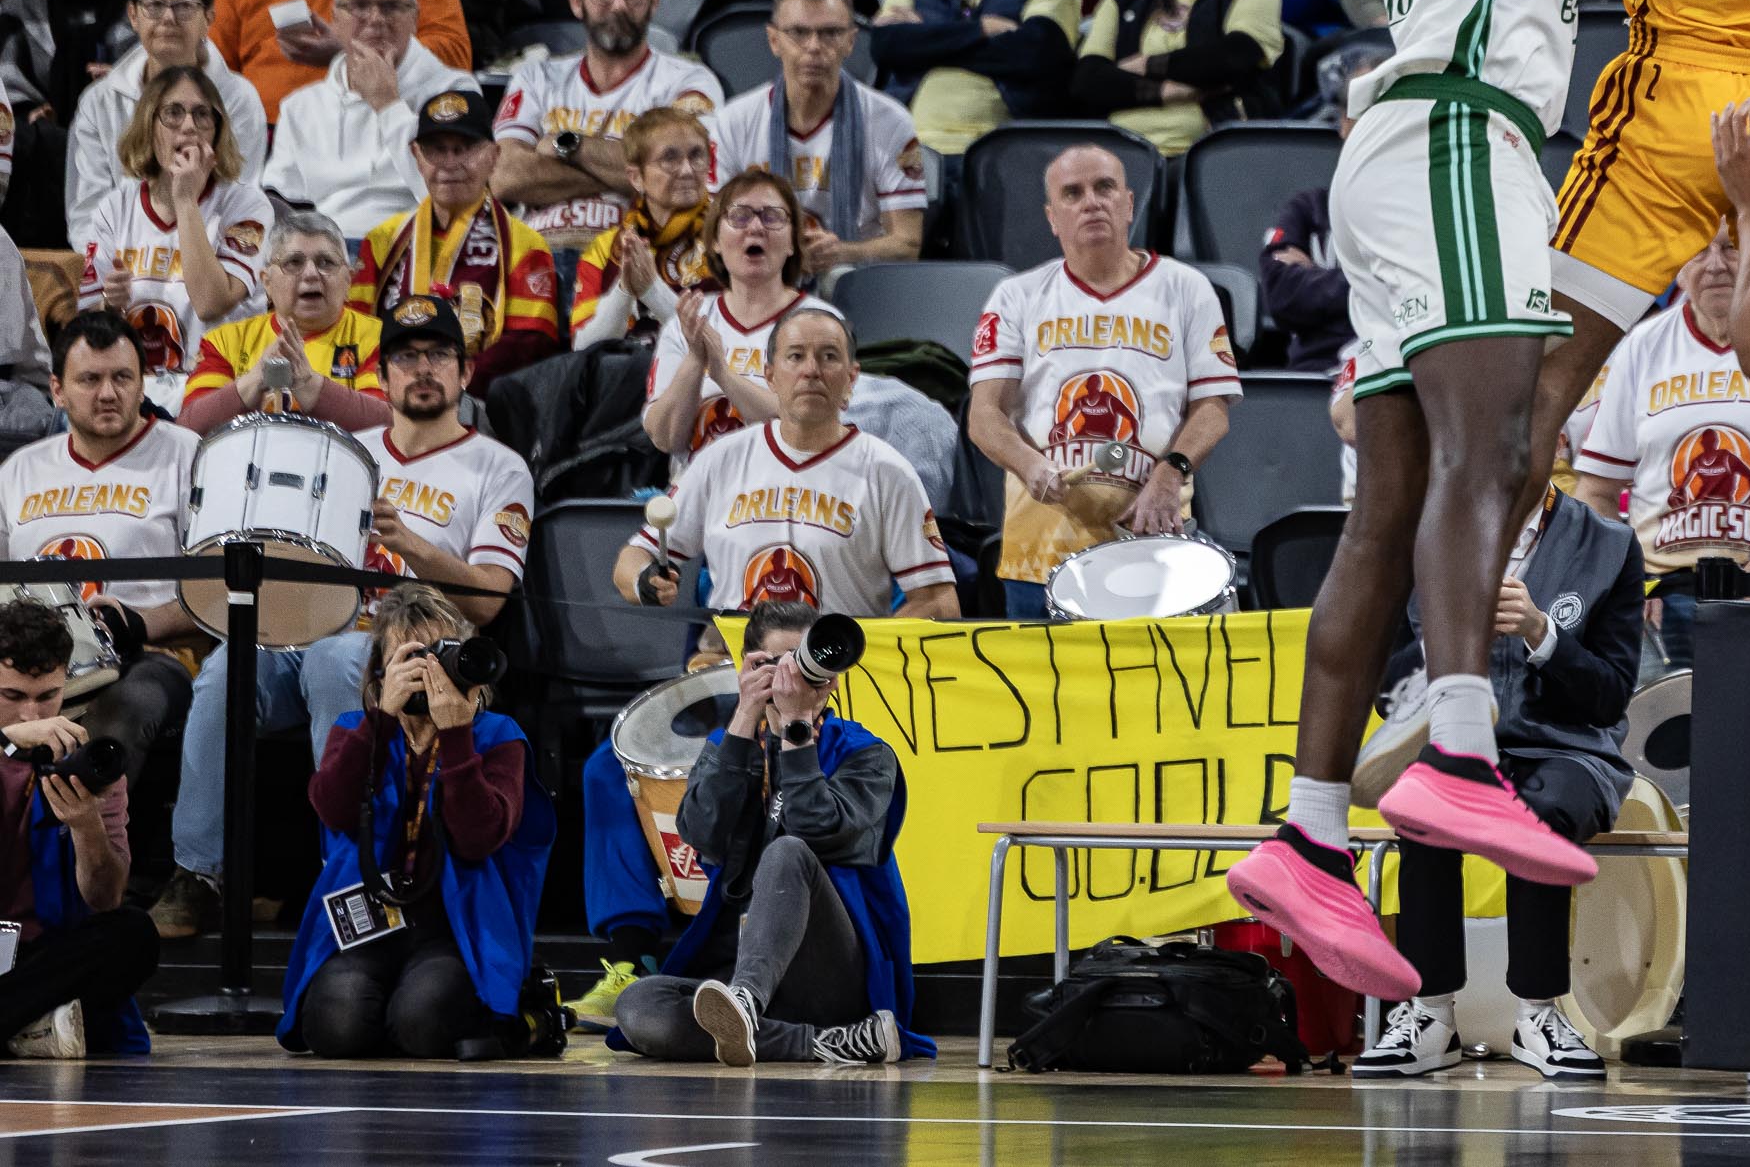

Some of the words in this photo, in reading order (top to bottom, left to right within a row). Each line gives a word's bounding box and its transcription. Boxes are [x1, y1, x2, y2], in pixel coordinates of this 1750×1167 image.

[1644, 62, 1660, 101] 2
[1036, 314, 1173, 360] ORLEANS
[18, 484, 151, 524] ORLEANS
[382, 477, 457, 526] EANS
[726, 486, 858, 537] ORLEANS
[920, 619, 1072, 752] EST
[770, 791, 784, 822] ONY
